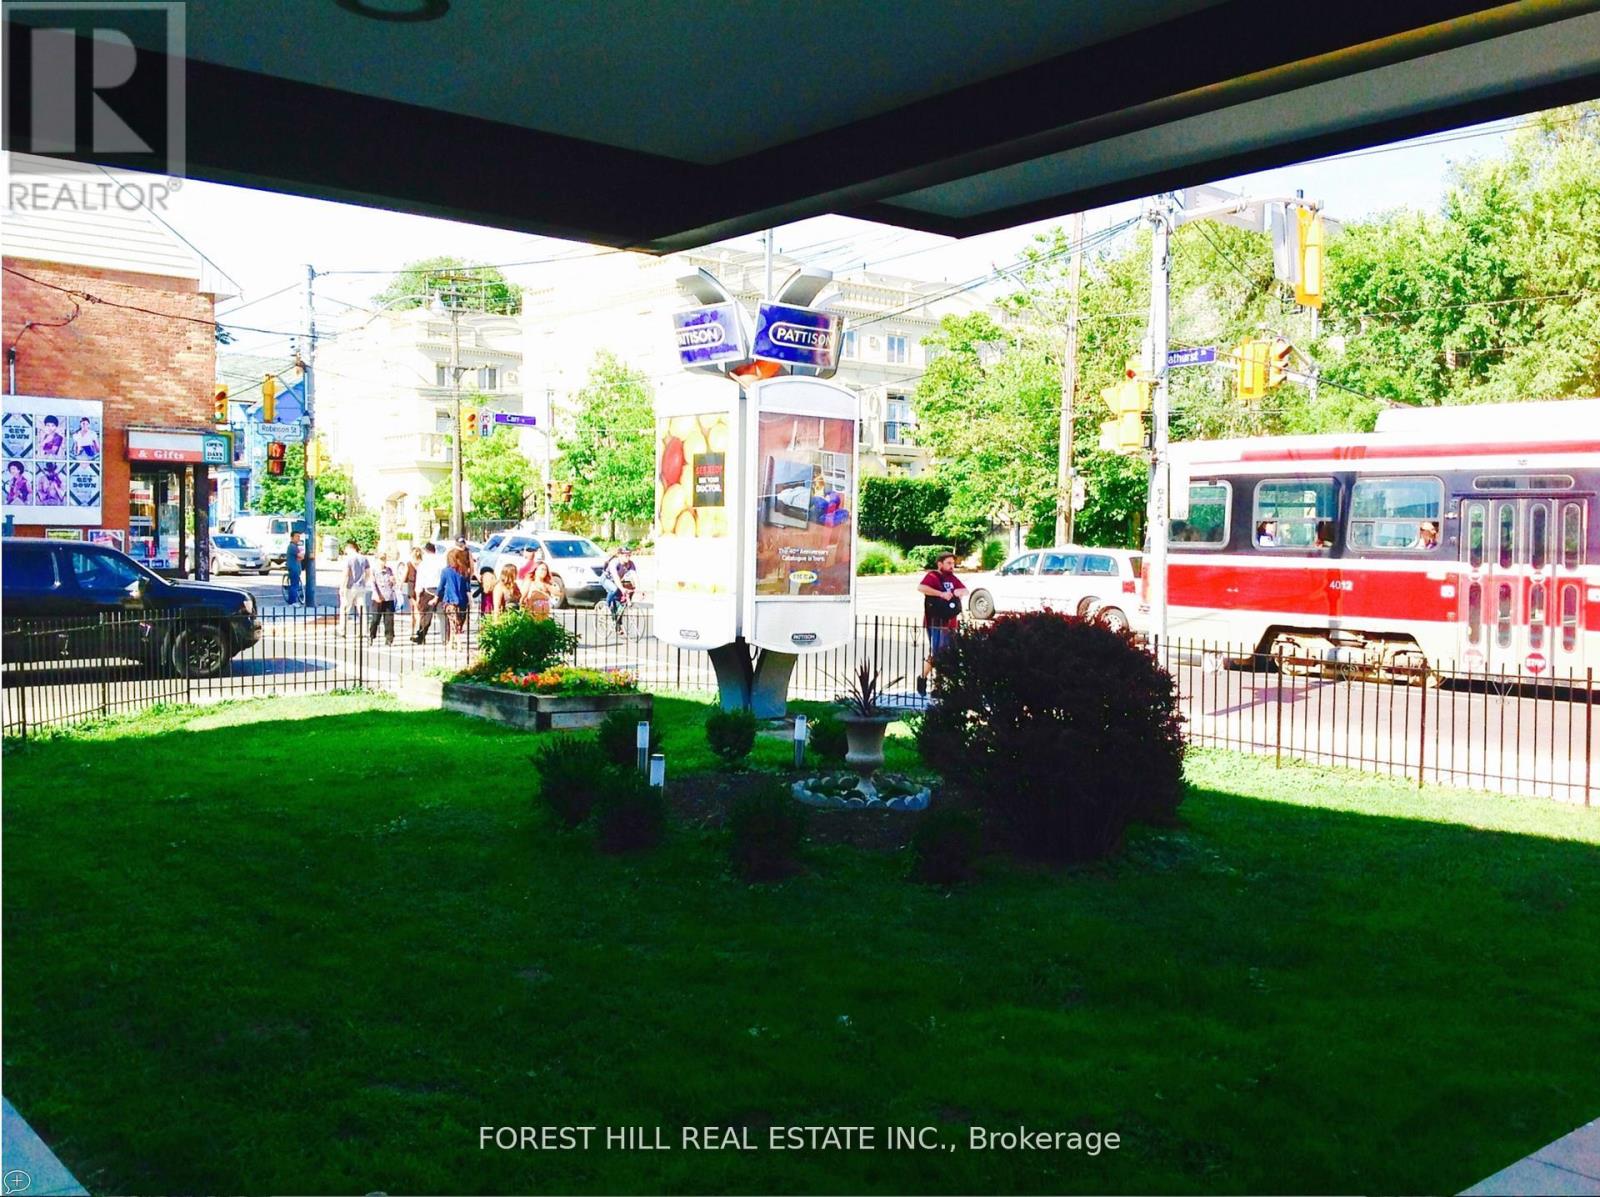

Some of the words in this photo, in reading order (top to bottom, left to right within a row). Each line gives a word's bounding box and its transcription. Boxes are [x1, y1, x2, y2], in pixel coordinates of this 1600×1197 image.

[1168, 351, 1199, 364] athurst
[261, 424, 290, 433] Robinson
[290, 426, 297, 434] St
[138, 449, 148, 459] &
[153, 450, 185, 460] Gifts
